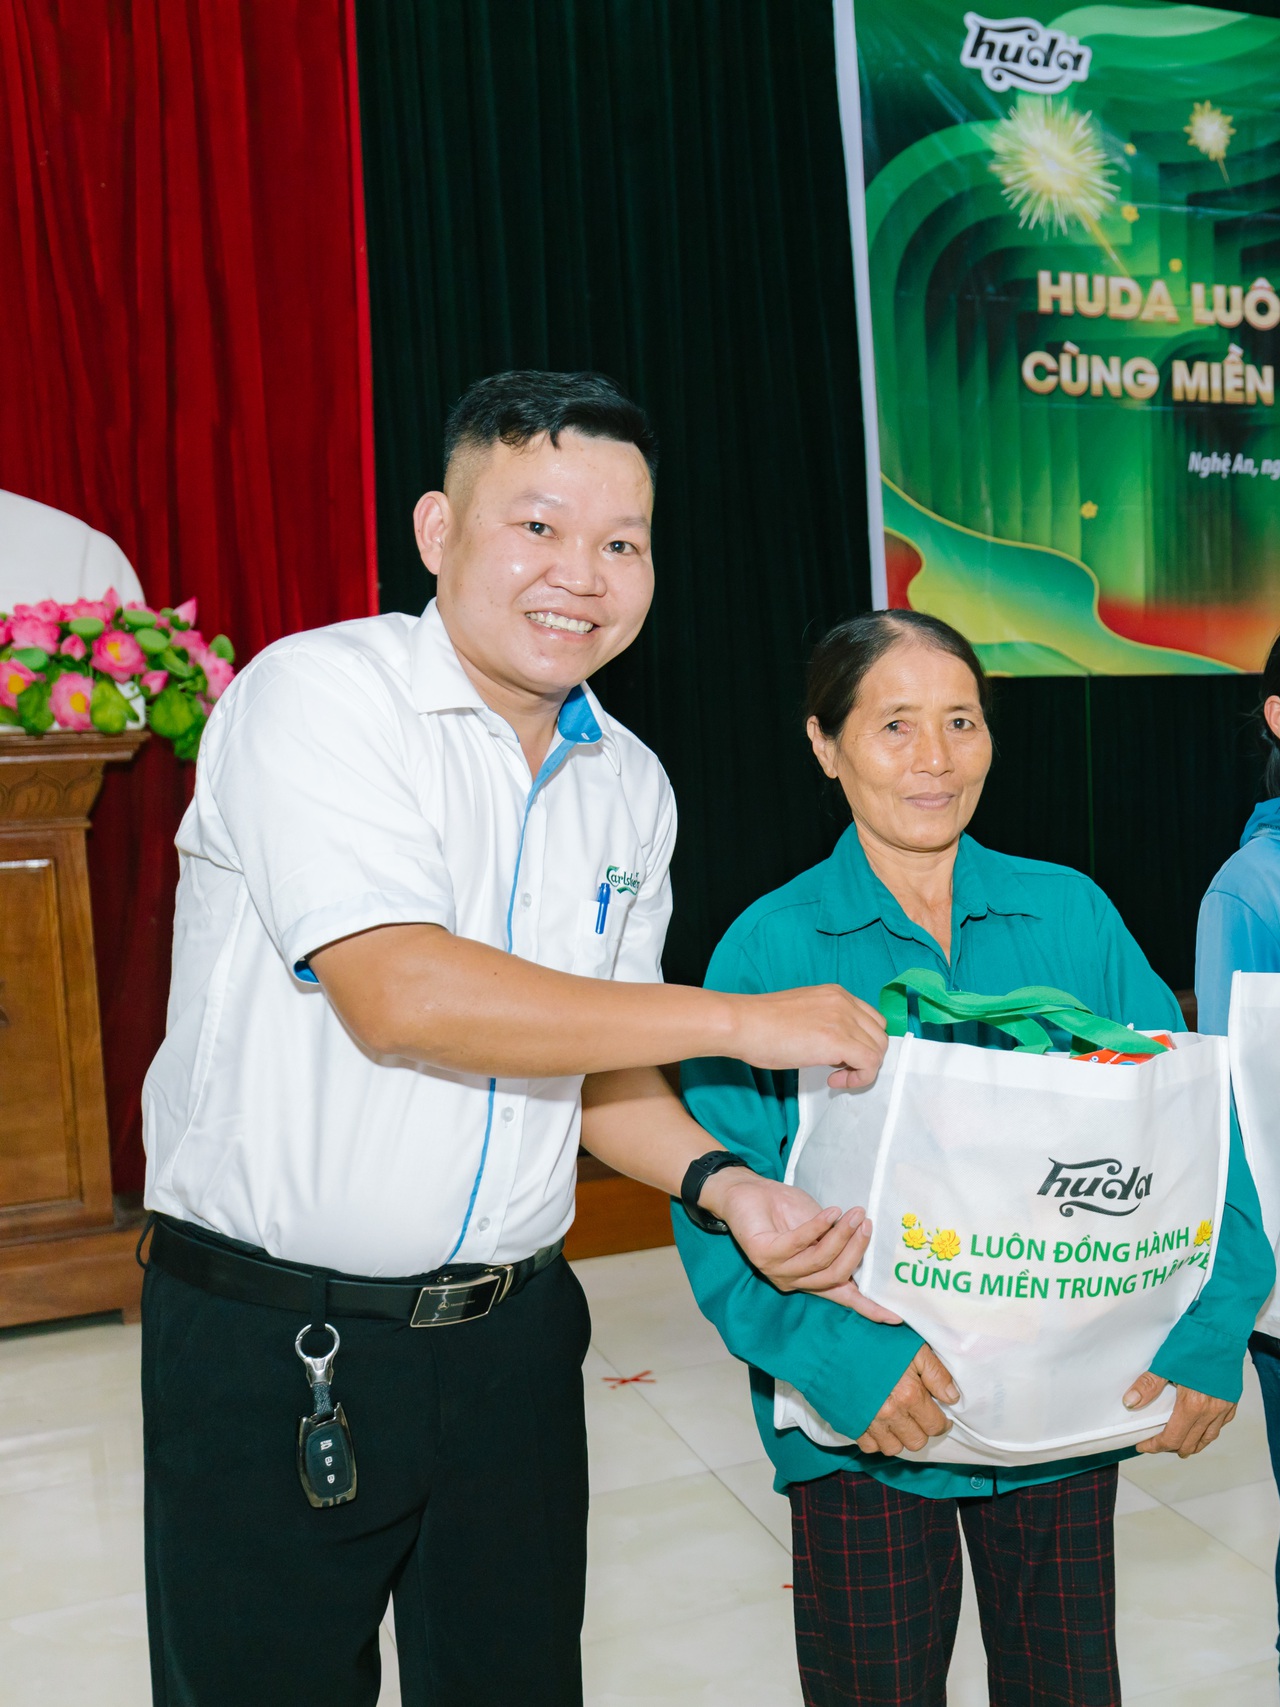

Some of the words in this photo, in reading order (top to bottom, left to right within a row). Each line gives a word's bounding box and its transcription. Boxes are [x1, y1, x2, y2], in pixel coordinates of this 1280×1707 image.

[970, 24, 1084, 84] huda
[1037, 270, 1179, 323] HUDA
[1022, 341, 1160, 400] CÙNG
[1172, 343, 1274, 406] MIỀN
[1188, 452, 1231, 479] Nghệ
[1232, 453, 1259, 477] An,
[1037, 1157, 1153, 1217] huda
[970, 1233, 1046, 1262] LUÔN
[1053, 1234, 1130, 1264] ĐỒNG
[1135, 1226, 1190, 1261] HÀNH
[894, 1260, 971, 1294] CÙNG
[980, 1269, 1049, 1299] MIỀN
[1056, 1274, 1138, 1300] TRUNG
